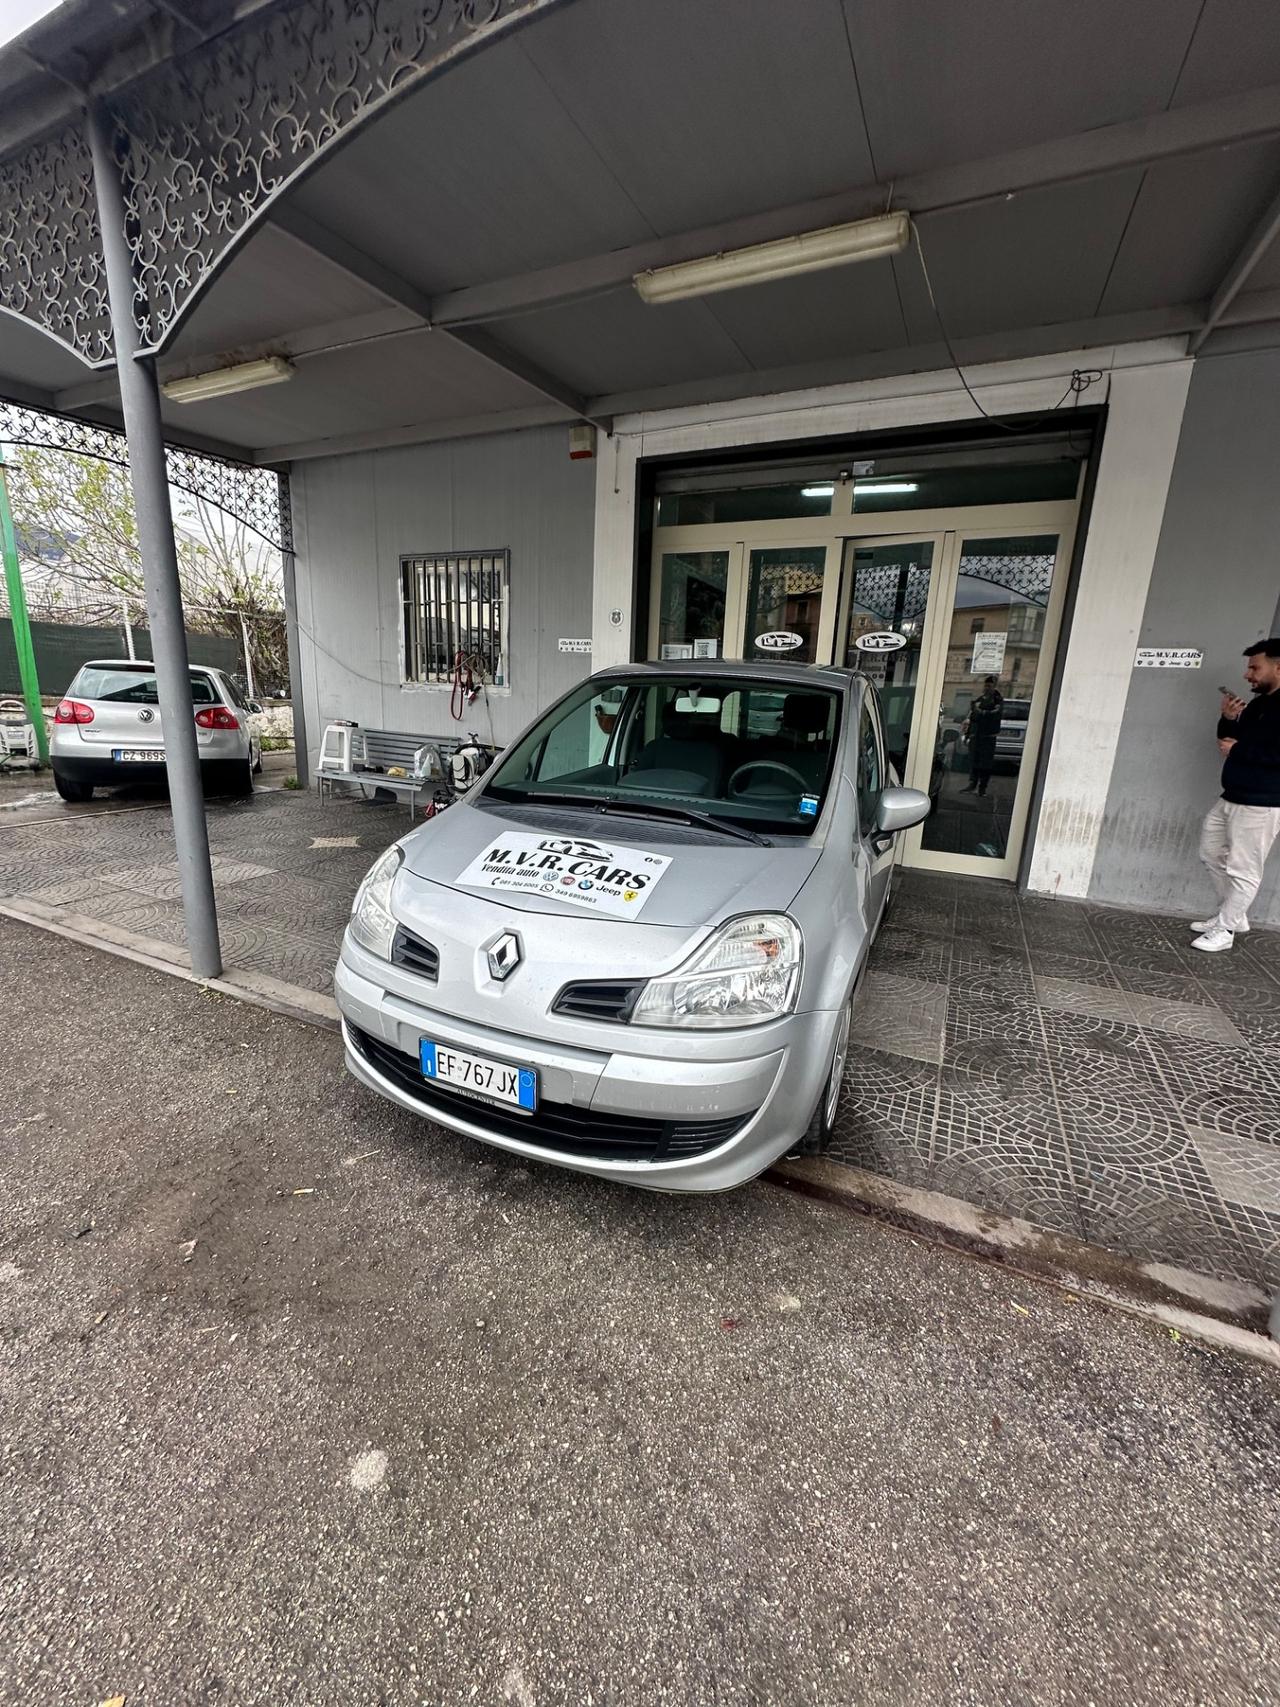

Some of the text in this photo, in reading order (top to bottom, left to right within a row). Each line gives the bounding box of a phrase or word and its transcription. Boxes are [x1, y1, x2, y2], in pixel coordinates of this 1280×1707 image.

[122, 751, 136, 760] CZ
[481, 864, 540, 878] Vendita auto
[596, 884, 621, 896] Jeep
